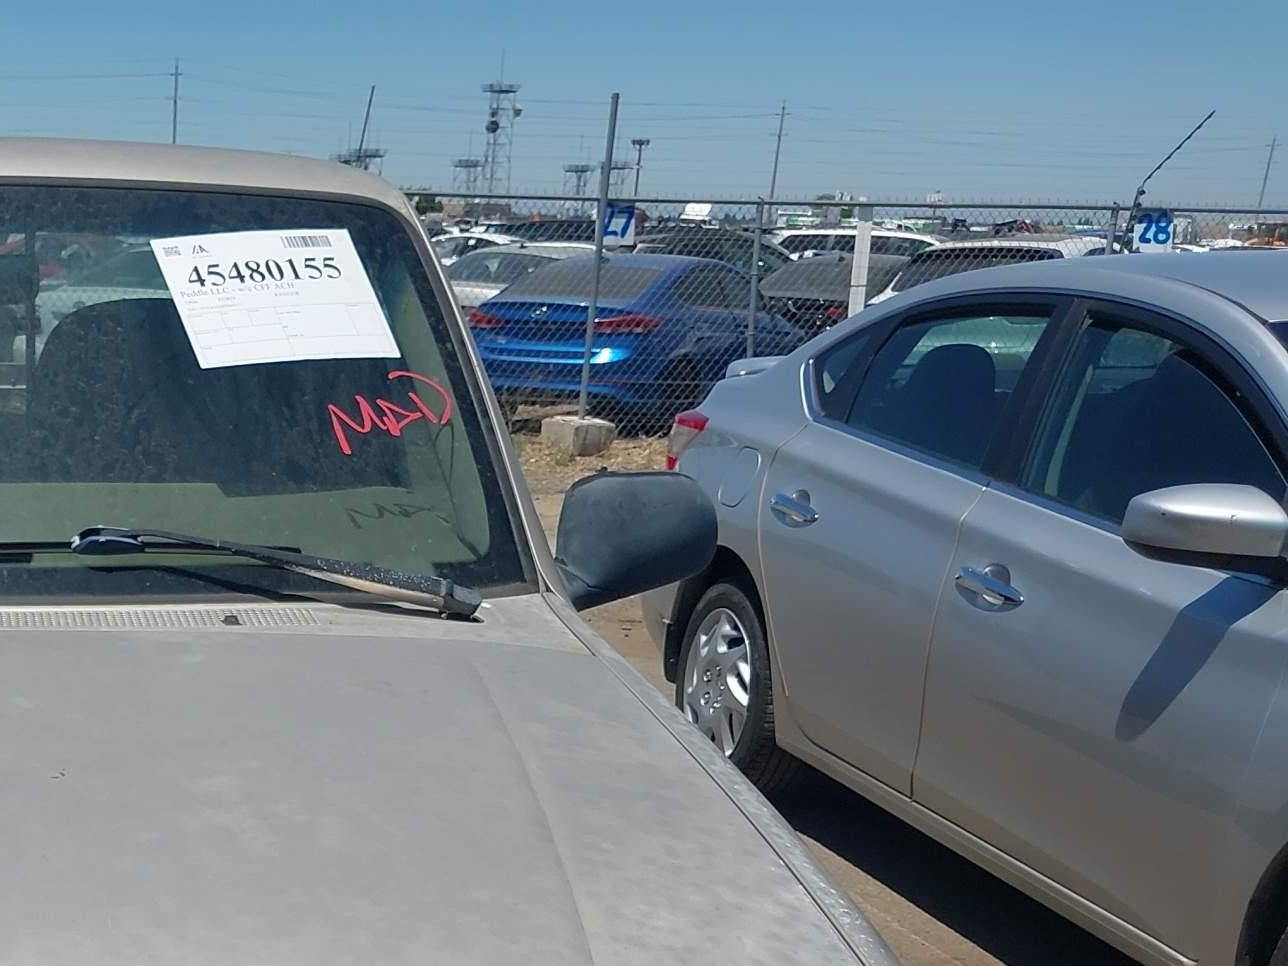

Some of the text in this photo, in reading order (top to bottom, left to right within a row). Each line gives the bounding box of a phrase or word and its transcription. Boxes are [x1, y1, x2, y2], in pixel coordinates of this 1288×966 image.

[602, 202, 635, 239] 27
[1136, 213, 1174, 245] 28
[187, 256, 343, 288] 45480155
